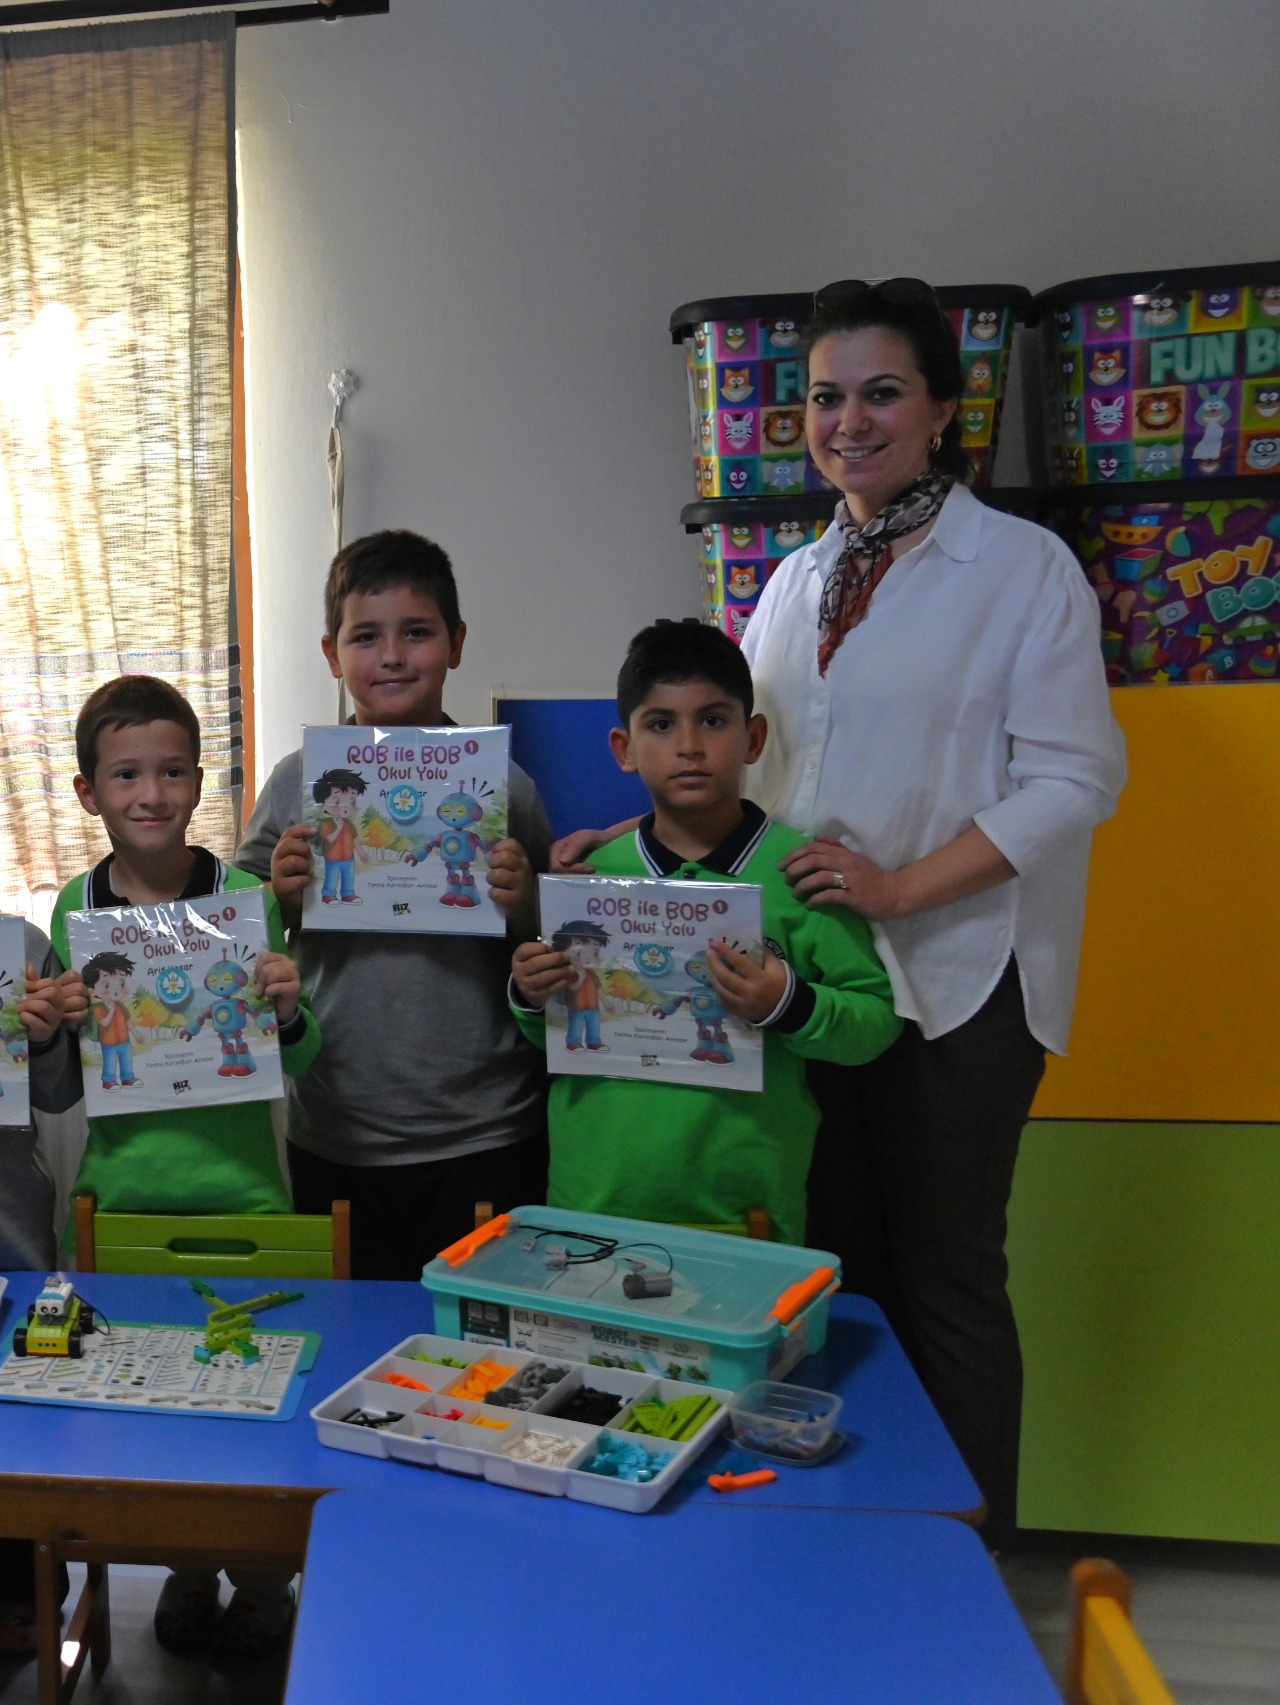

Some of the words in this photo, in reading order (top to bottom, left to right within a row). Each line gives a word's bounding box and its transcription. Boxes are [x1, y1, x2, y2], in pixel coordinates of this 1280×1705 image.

[1149, 331, 1237, 386] FUN
[1245, 327, 1280, 376] B
[1166, 535, 1274, 598] TOY
[347, 745, 388, 764] ROB
[394, 746, 415, 762] ile
[421, 745, 461, 765] BOB
[378, 766, 411, 781] Okul
[416, 766, 448, 781] Yolu
[587, 898, 631, 917] ROB
[638, 900, 659, 916] ile
[665, 902, 709, 922] BOB
[621, 919, 656, 935] Okul
[662, 921, 696, 937] Yolu
[143, 943, 176, 959] Okul
[181, 938, 210, 954] Yolu
[590, 1325, 629, 1338] ROBOT
[593, 1333, 638, 1347] MASTER
